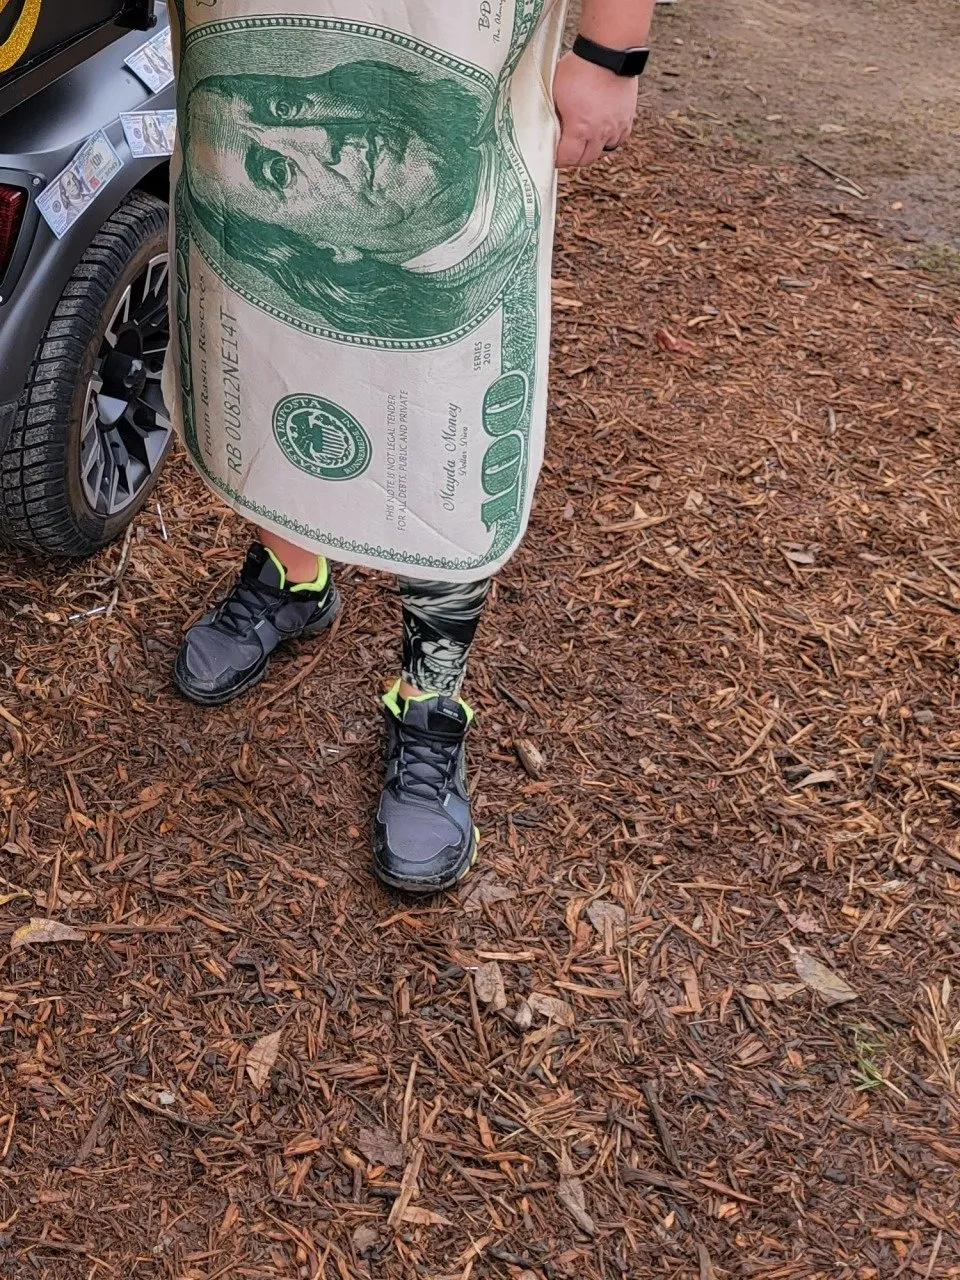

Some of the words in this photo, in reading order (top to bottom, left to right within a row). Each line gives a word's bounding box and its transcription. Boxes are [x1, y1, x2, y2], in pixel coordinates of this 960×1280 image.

[506, 146, 526, 177] THERE
[521, 178, 534, 205] BEEN
[196, 273, 208, 353] Reserves
[473, 340, 483, 372] SERIES
[483, 343, 492, 366] 2010
[199, 358, 210, 407] Rasta
[276, 397, 323, 434] IMPOSTA
[386, 394, 397, 426] TENDER
[398, 389, 409, 423] PRIVATE
[201, 412, 214, 459] From
[386, 427, 396, 451] LEGAL
[398, 425, 408, 443] AND
[440, 402, 461, 452] Money
[459, 425, 469, 448] Diva
[226, 443, 242, 476] RB
[279, 434, 322, 474] RASTA
[386, 451, 395, 471] NOT
[398, 444, 408, 472] PUBLIC
[459, 450, 468, 477] Dollar
[480, 369, 531, 533] 100
[386, 480, 395, 503] NOTE
[439, 459, 460, 512] Mayda
[386, 505, 395, 521] THIS
[397, 515, 407, 532] FOR
